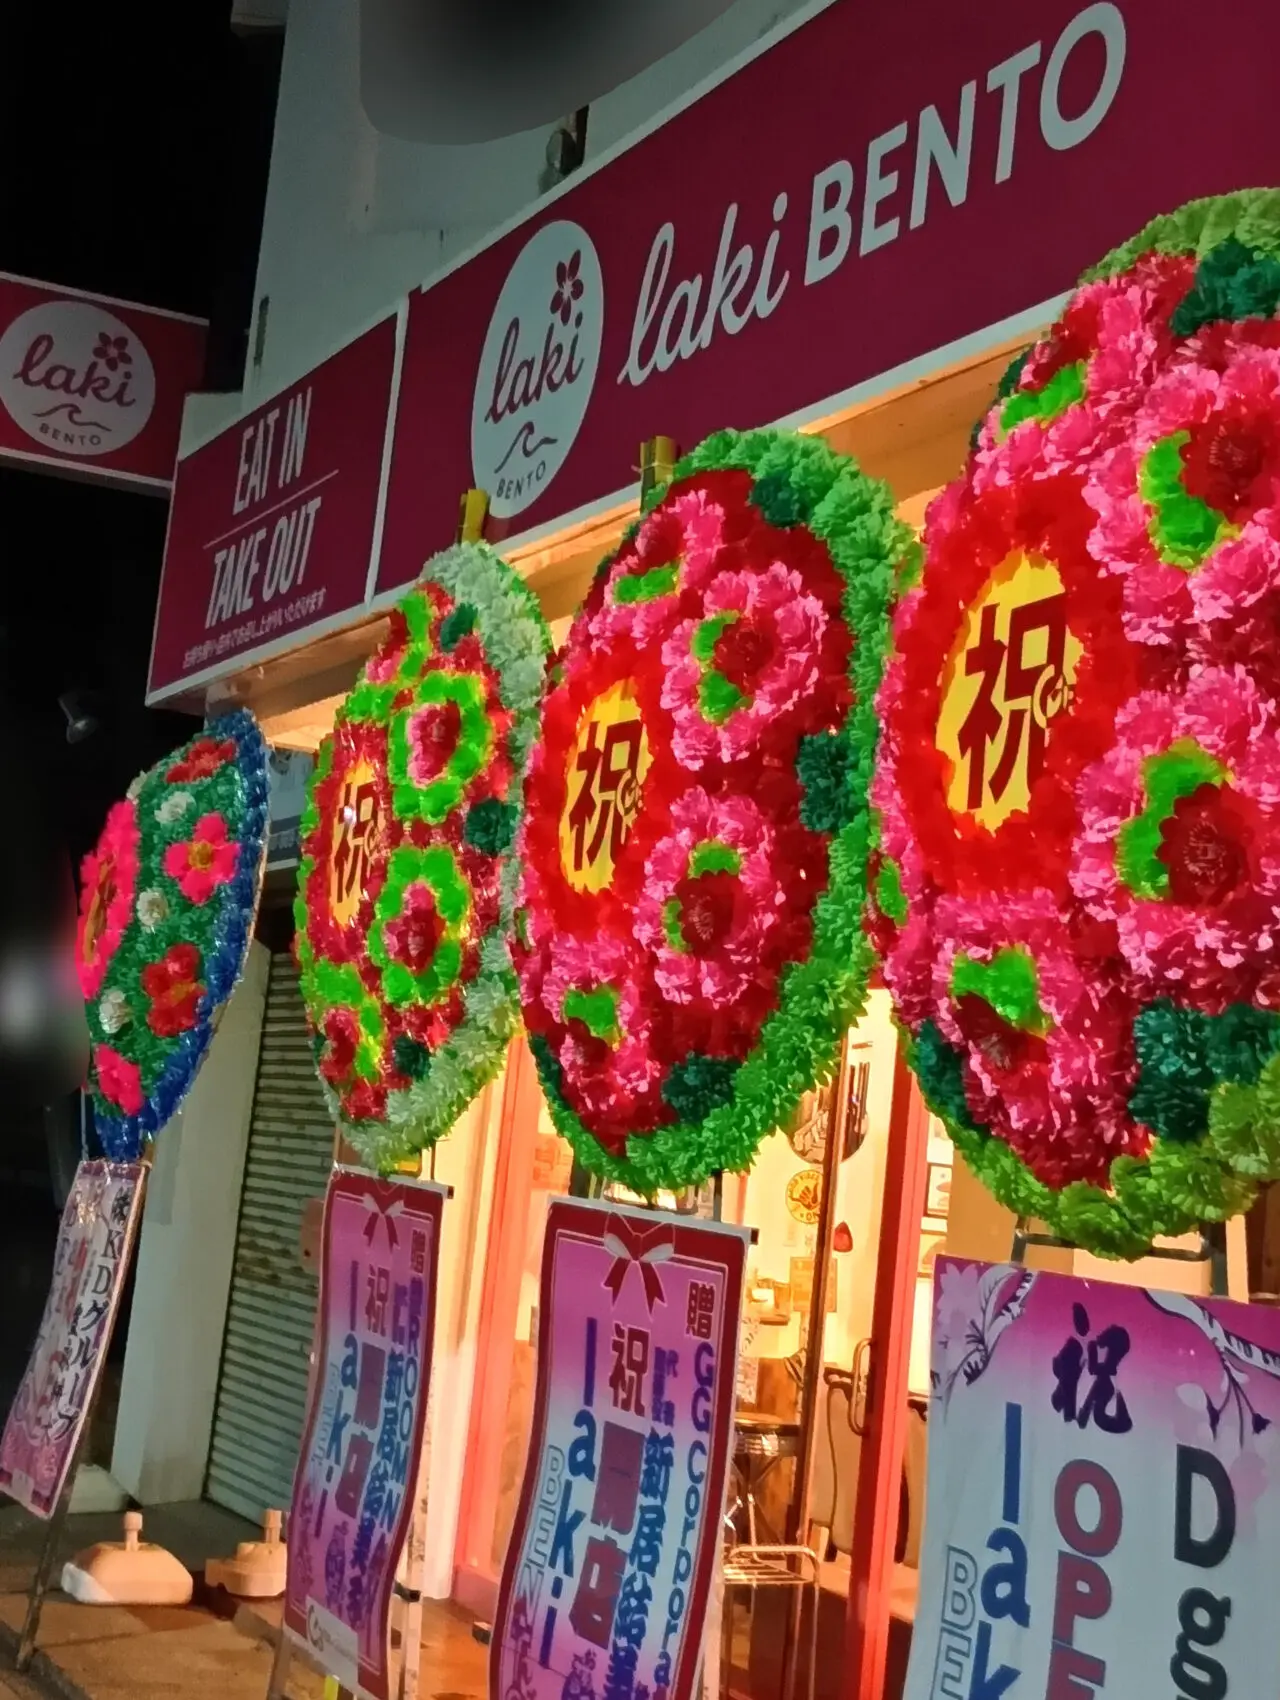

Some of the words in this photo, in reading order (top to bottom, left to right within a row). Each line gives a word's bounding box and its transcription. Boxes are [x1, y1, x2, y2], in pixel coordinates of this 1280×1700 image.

[616, 192, 790, 386] laki
[803, 1, 1127, 287] BENTO
[12, 334, 136, 407] laki
[40, 422, 102, 446] BENTO
[485, 312, 584, 424] laki
[233, 407, 280, 516] EAT
[278, 386, 313, 489] IN
[496, 459, 547, 500] BENTO
[205, 528, 267, 630] TAKE
[262, 496, 322, 602] OUT
[957, 592, 1067, 811] 祝
[569, 719, 643, 872] 祝
[685, 1281, 716, 1340] 贈
[1051, 1302, 1134, 1434] 祝
[314, 1260, 359, 1539] laki
[691, 1341, 715, 1434] GG
[539, 1317, 598, 1669] laki
[967, 1402, 1031, 1700] lak
[1169, 1444, 1236, 1700] Dg
